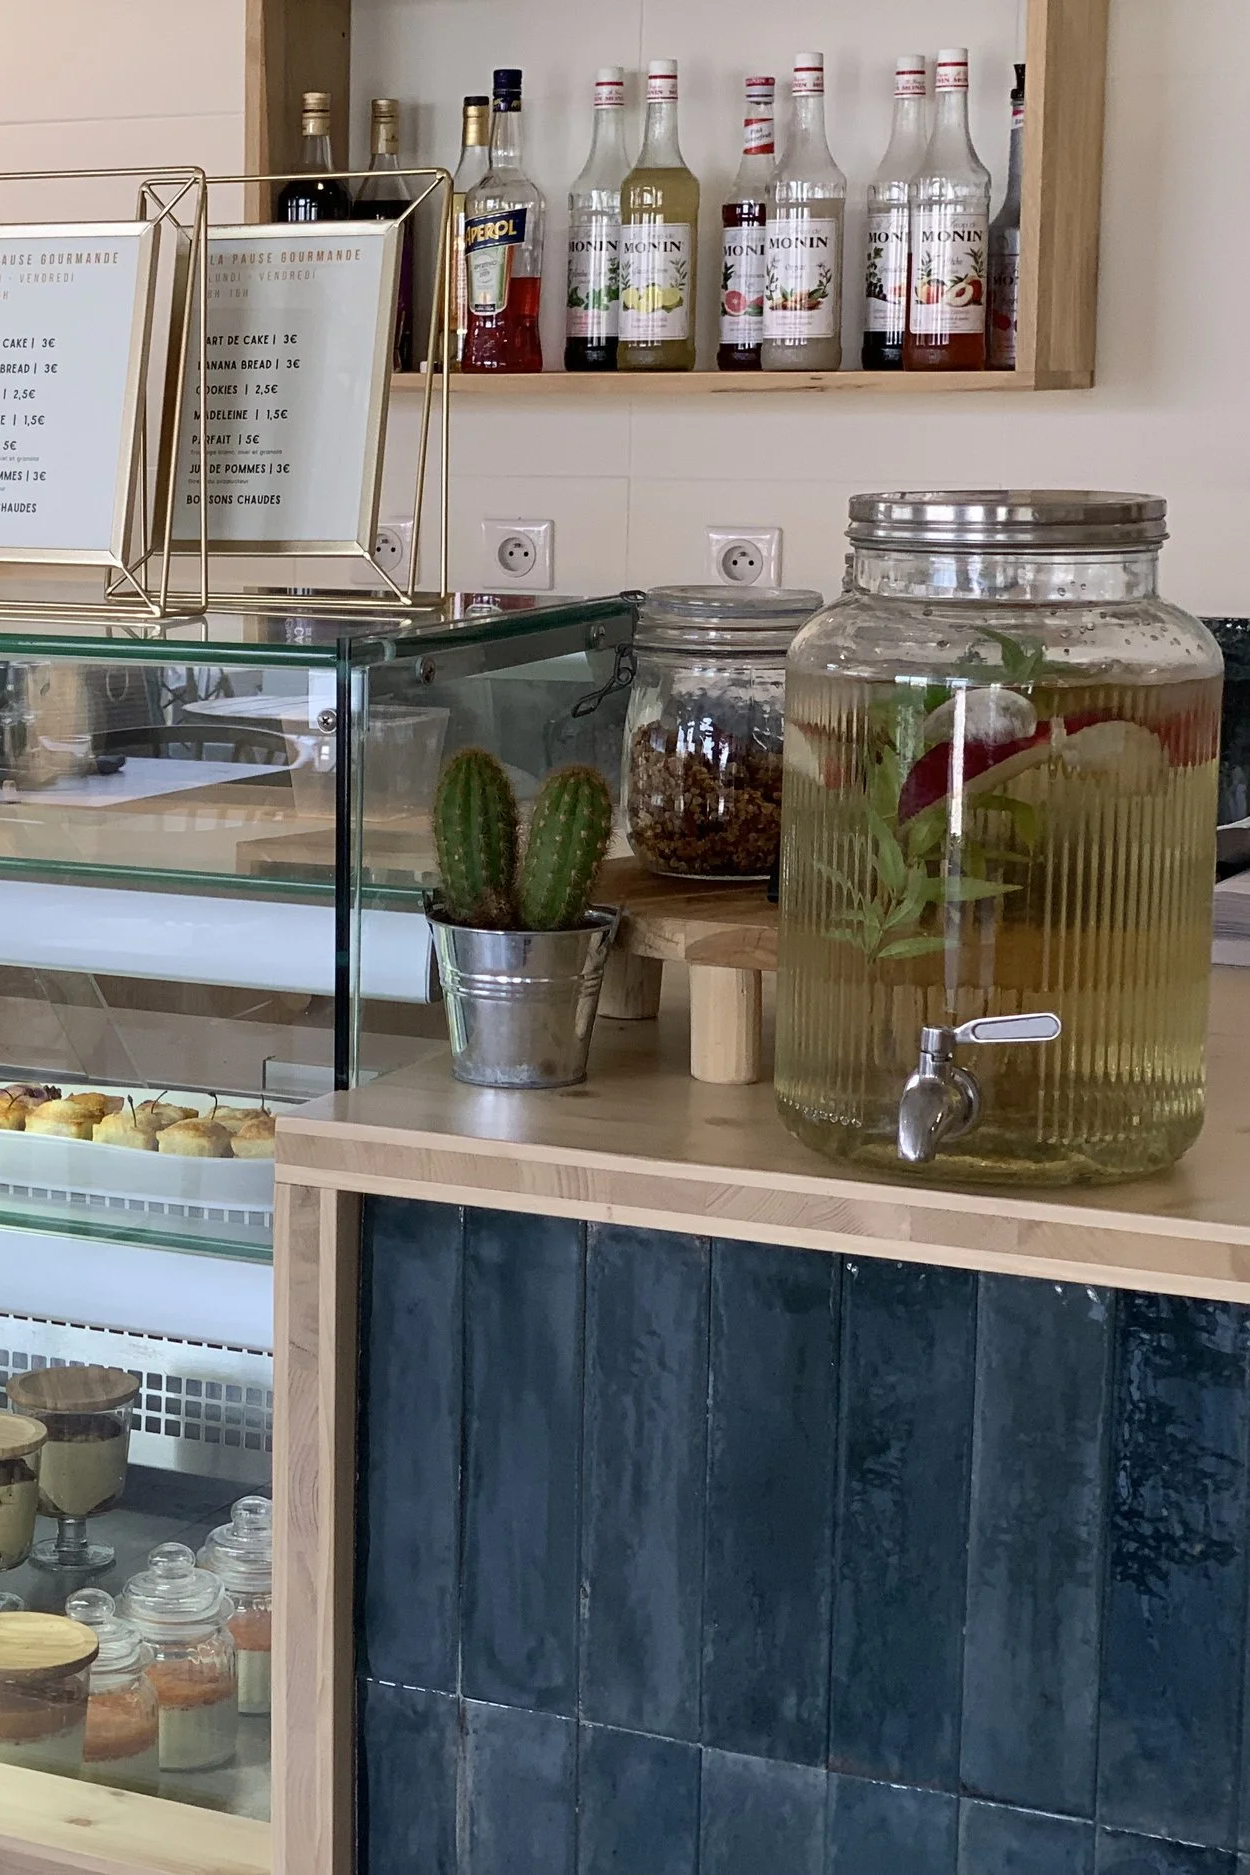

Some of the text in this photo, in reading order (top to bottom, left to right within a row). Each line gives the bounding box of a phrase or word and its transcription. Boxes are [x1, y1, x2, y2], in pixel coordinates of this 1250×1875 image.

[465, 219, 517, 247] APEROL
[922, 230, 982, 243] MONIN
[624, 241, 682, 253] MONIN
[769, 237, 828, 249] MONIN
[723, 245, 765, 256] MONI
[41, 252, 119, 265] GOURMANDE
[210, 249, 361, 266] LA PAUSE GOURMANDE
[19, 272, 74, 284] VENDREDI
[259, 270, 317, 281] VENDREDI
[2, 338, 28, 348] CAKE
[41, 338, 56, 348] 3€
[206, 335, 223, 345] ART
[228, 335, 240, 345] DE
[243, 335, 269, 345] CAKE
[283, 334, 298, 344] 3€
[0, 364, 30, 374] BREAD
[44, 363, 58, 374] 3€
[241, 360, 272, 370] BREAD
[286, 359, 301, 369] 3€
[13, 389, 36, 401] 2,5€
[255, 384, 278, 396] 2,5€
[24, 415, 45, 427] 1,5€
[266, 410, 288, 422] 1,5€
[245, 435, 260, 445] 5€
[3, 441, 17, 451] 5€
[209, 464, 221, 474] DE
[225, 464, 266, 474] POMMES
[276, 464, 290, 474] 3€
[33, 471, 46, 481] 3€
[237, 494, 281, 505] CHAUDES
